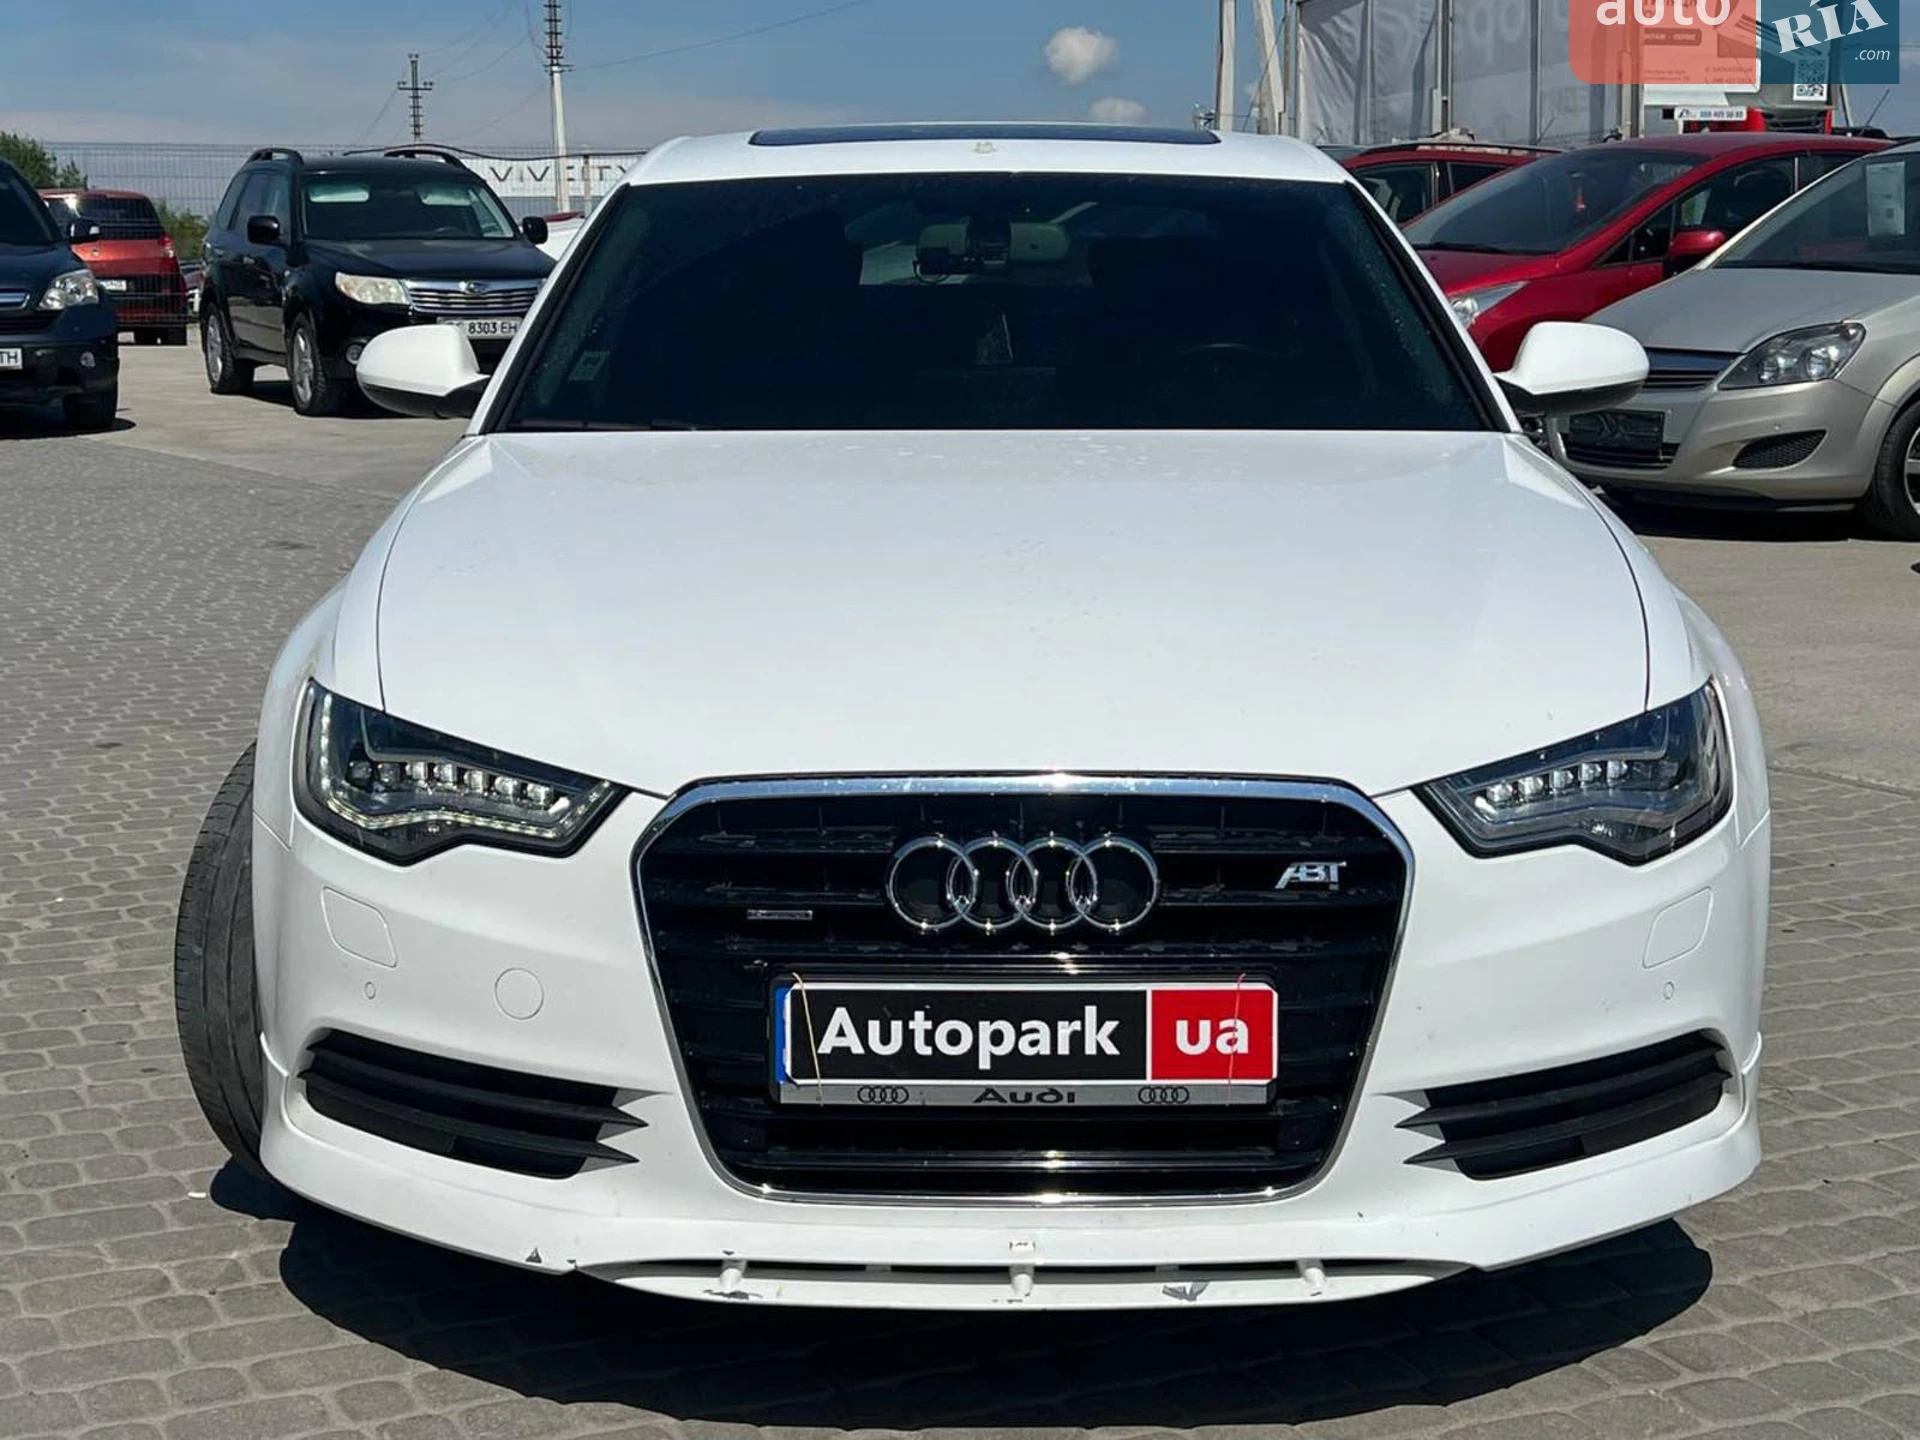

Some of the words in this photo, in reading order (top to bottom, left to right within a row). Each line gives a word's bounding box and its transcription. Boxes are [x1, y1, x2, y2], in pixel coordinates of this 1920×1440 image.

[468, 322, 498, 334] 8303
[500, 322, 518, 334] EH
[1275, 862, 1347, 890] ABT
[817, 1005, 1121, 1070] Autopark
[1175, 1018, 1249, 1055] ua
[973, 1087, 1076, 1104] Audi
